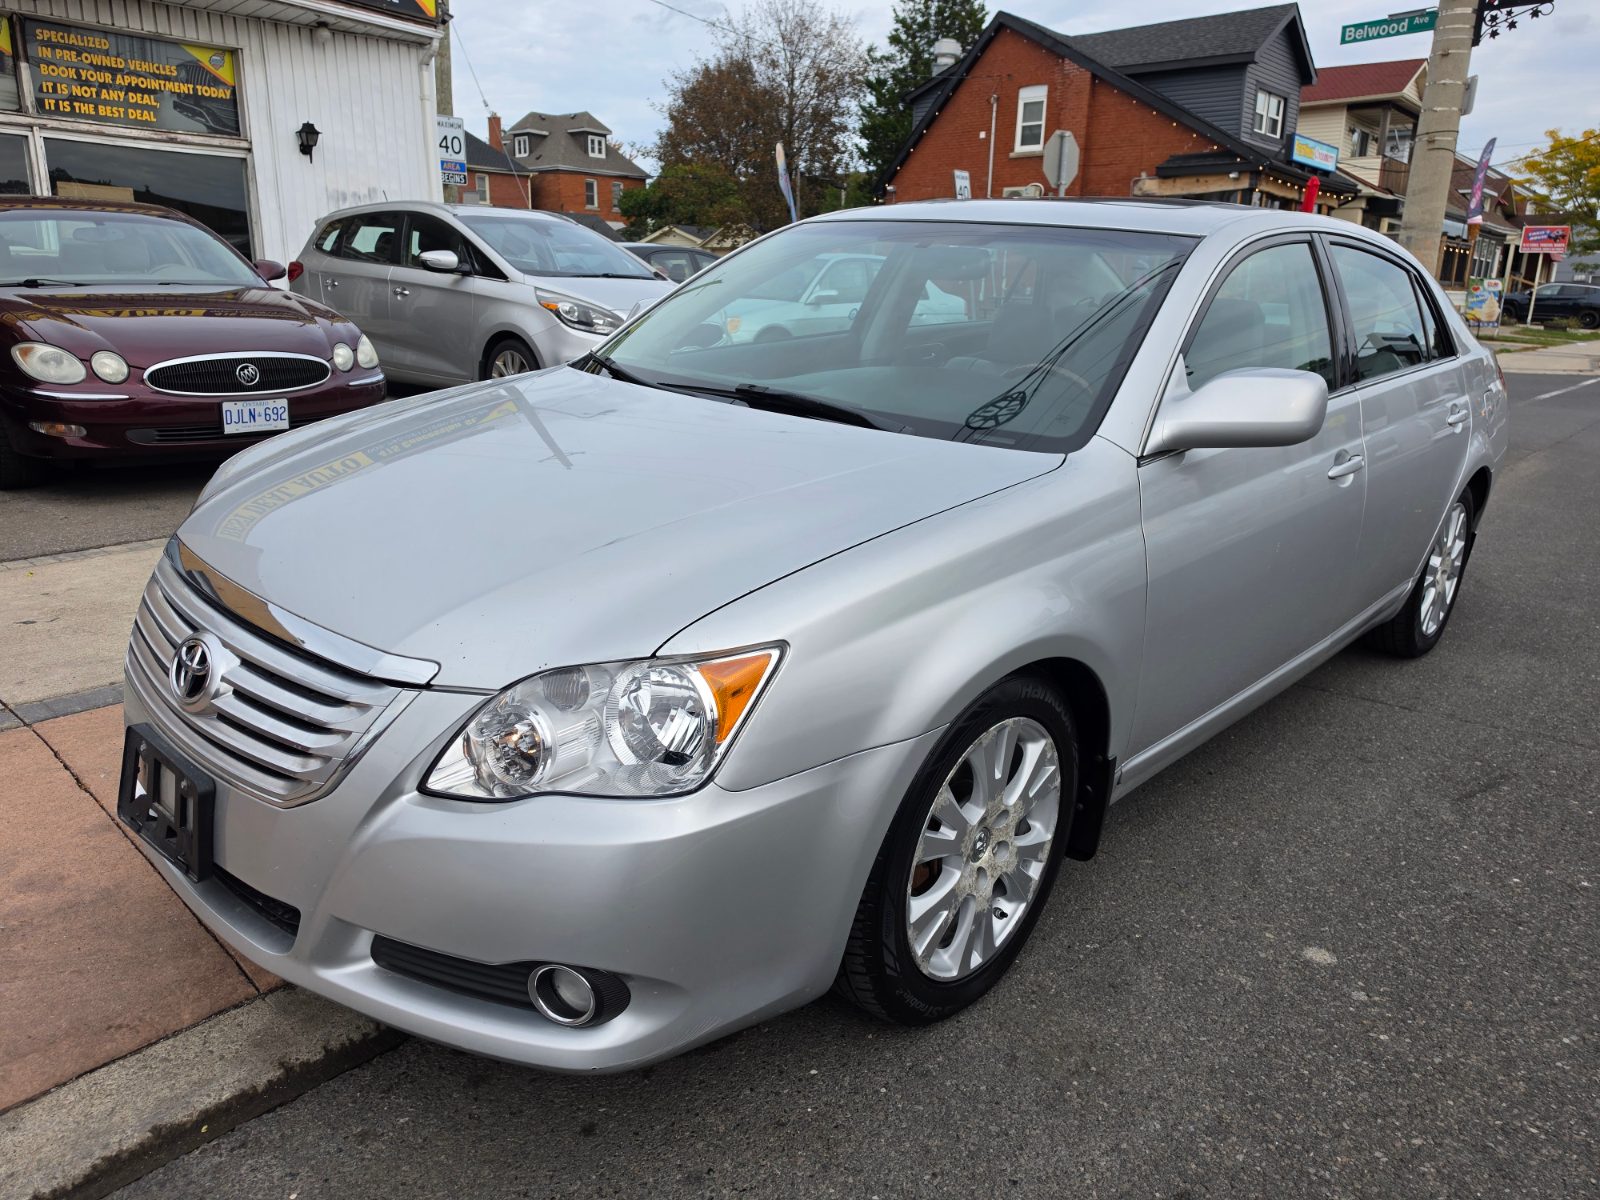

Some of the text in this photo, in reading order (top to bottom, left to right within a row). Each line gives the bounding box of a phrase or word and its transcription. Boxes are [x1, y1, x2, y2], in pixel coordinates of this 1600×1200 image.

[35, 28, 110, 50] SPECIALIZED
[1344, 16, 1430, 41] Belwood Ave
[38, 46, 178, 76] IN PRE-OWNED VEHICLES
[39, 64, 231, 100] BOOK YOUR APPOINTMENT TODAY
[42, 81, 160, 109] IT IS NOT ANY DEAL,
[44, 98, 157, 122] IT IS THE BEST DEAL
[437, 121, 462, 130] MAXIMUM
[439, 135, 462, 155] 40
[443, 162, 461, 171] AREA
[440, 173, 465, 184] BEGINS
[264, 406, 287, 422] 692
